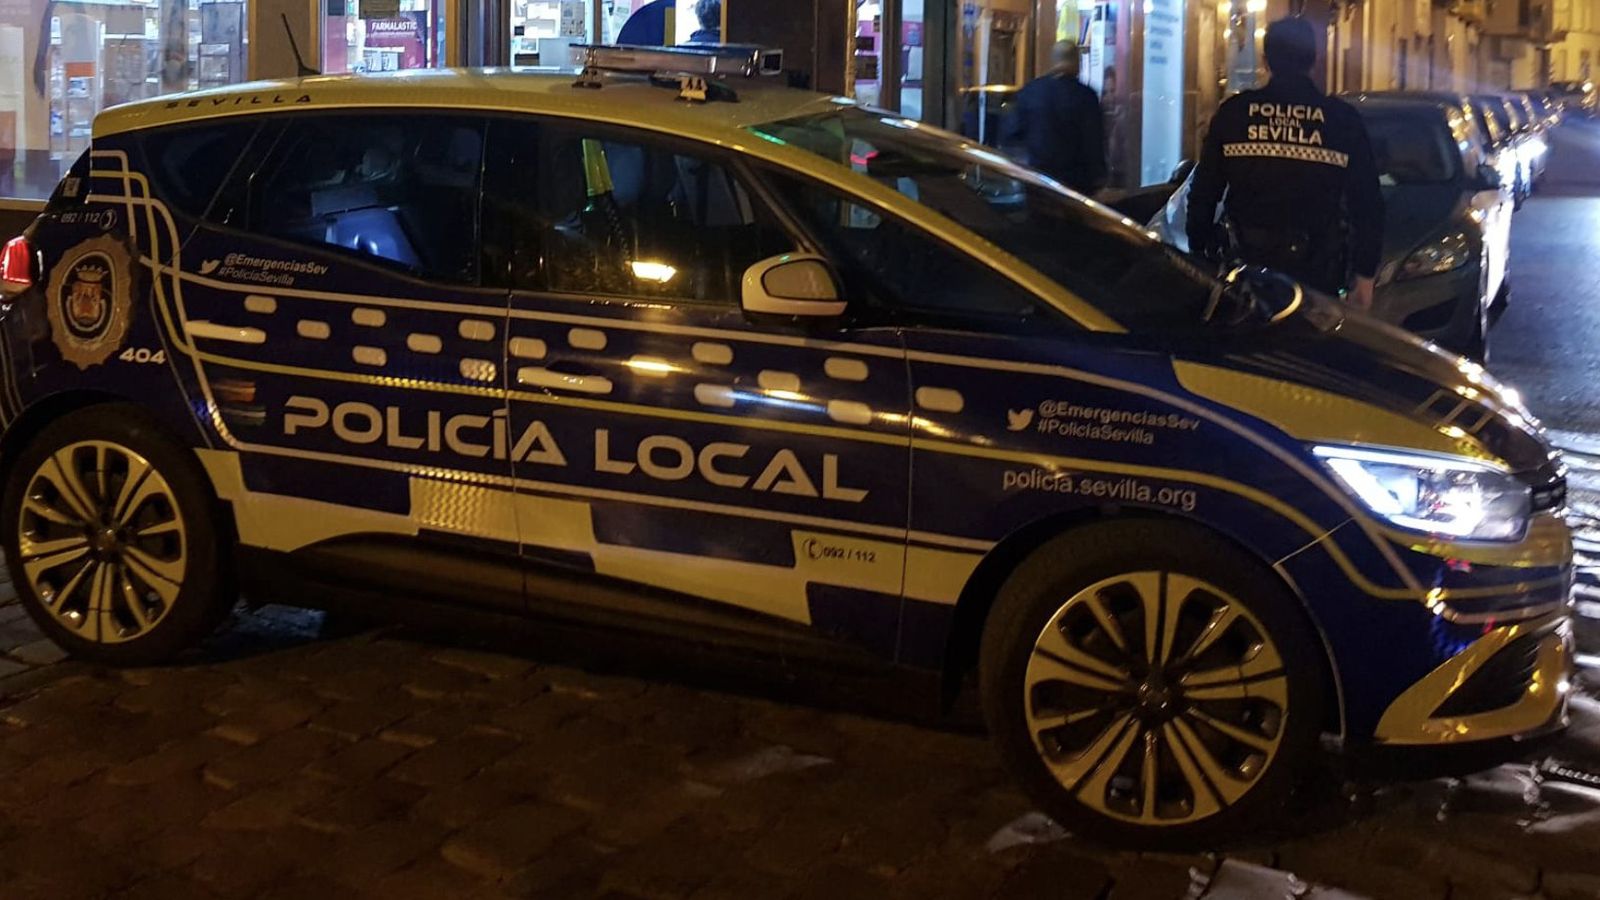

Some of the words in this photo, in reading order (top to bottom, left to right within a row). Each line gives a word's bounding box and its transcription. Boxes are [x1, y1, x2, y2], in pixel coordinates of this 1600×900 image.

[371, 21, 417, 31] FARMALASTIC
[165, 94, 311, 109] SEVILLA
[1248, 103, 1325, 123] POLICIA
[1269, 118, 1301, 128] LOCAL
[1247, 124, 1322, 145] SEVILLA
[85, 211, 100, 223] 112
[224, 253, 328, 274] @EmergenciasSev
[219, 266, 294, 285] #PoliciaSevilla
[119, 347, 166, 364] 404
[1039, 400, 1199, 430] @EmergenciasSev
[1038, 419, 1154, 445] #PoliciaSevilla
[284, 396, 567, 466] POLICÍA
[595, 429, 869, 502] LOCAL
[1003, 468, 1196, 511] policia.sevilla.org
[855, 550, 876, 563] 112
